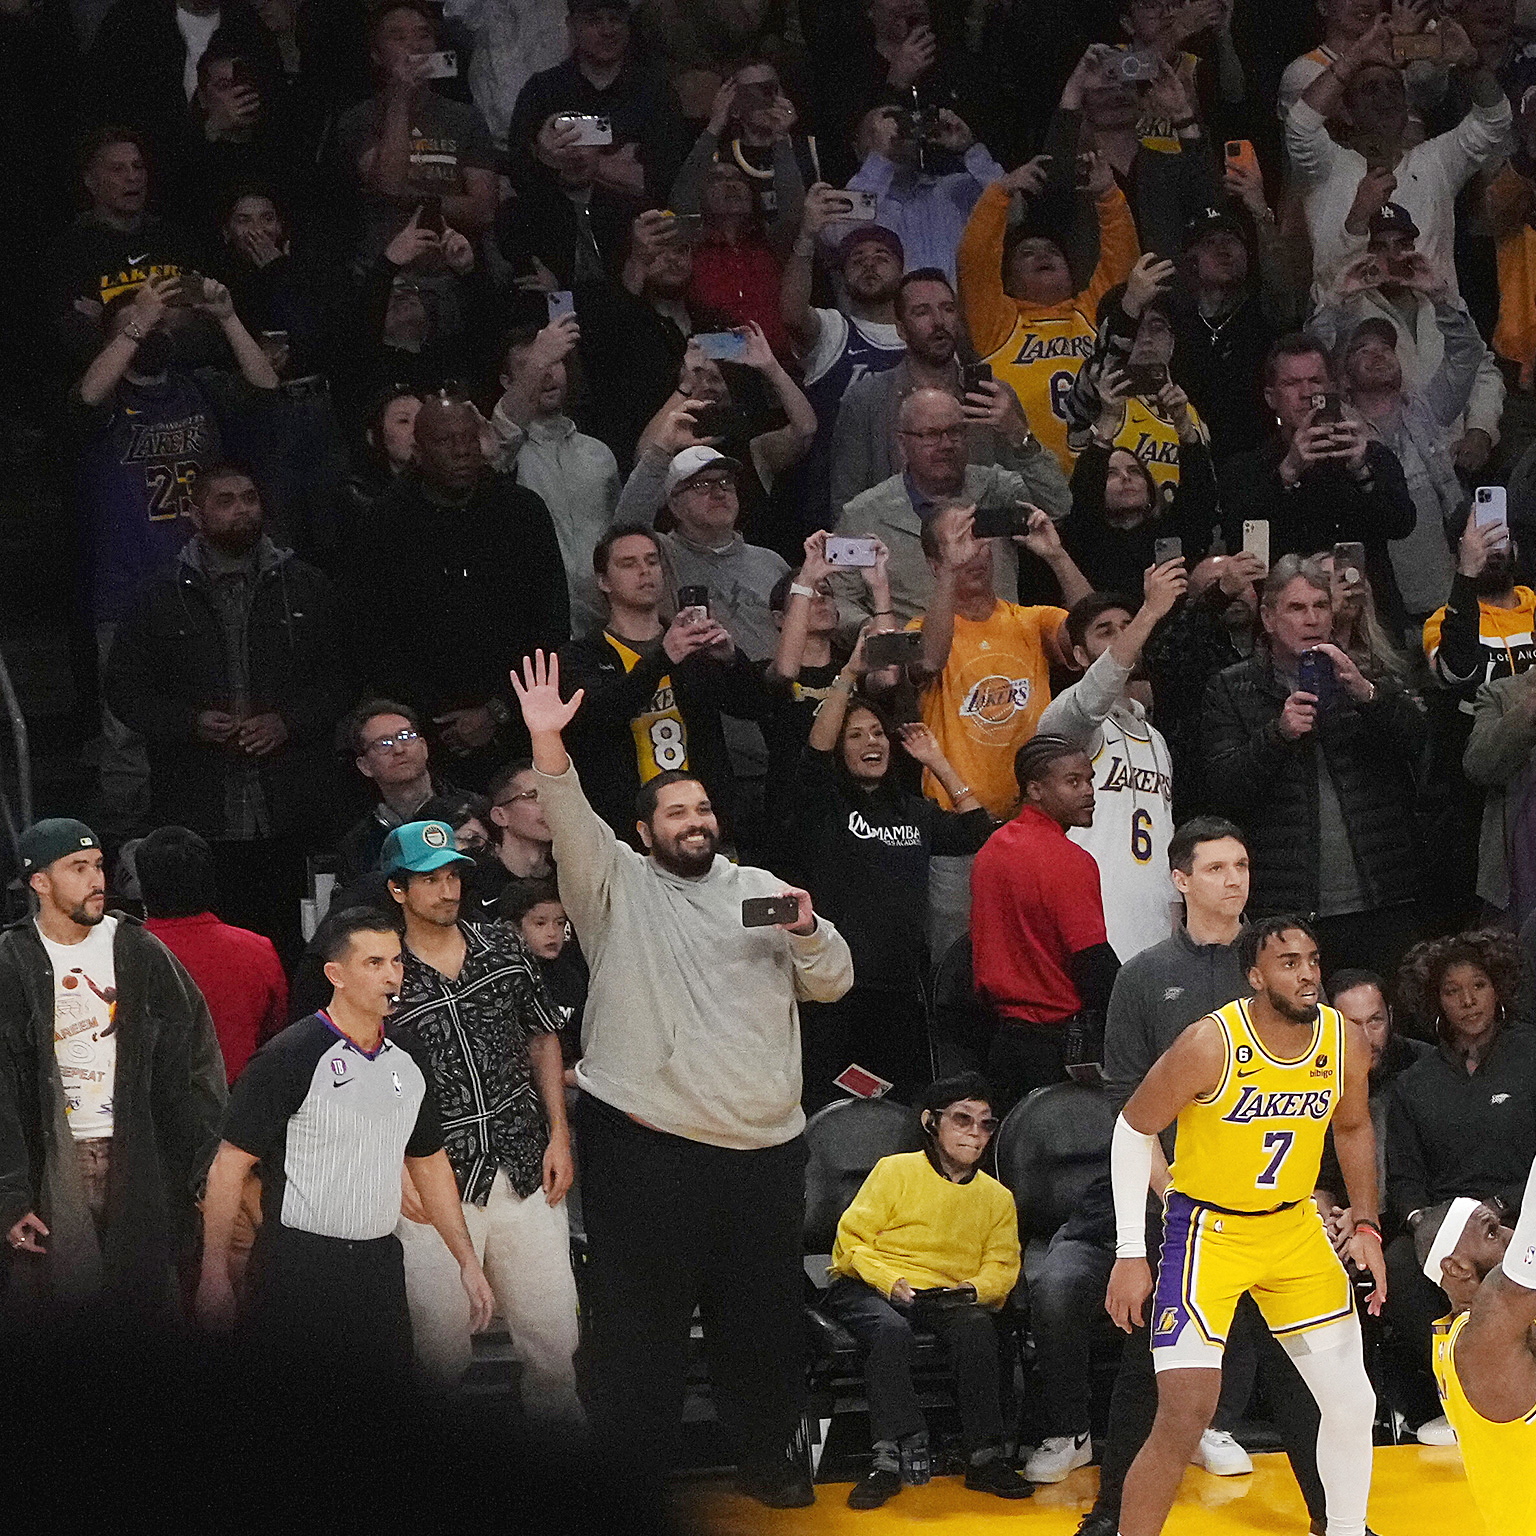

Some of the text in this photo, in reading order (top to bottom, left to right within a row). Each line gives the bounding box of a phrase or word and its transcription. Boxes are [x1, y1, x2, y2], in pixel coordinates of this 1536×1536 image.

[1008, 334, 1096, 365] LAKERS
[650, 719, 685, 769] 8
[1131, 808, 1153, 863] 6
[54, 1016, 99, 1041] AREEM
[60, 1066, 105, 1083] EPEAT
[1309, 1068, 1334, 1078] bibigo
[1219, 1086, 1332, 1125] LAKERS
[1253, 1130, 1294, 1187] 7
